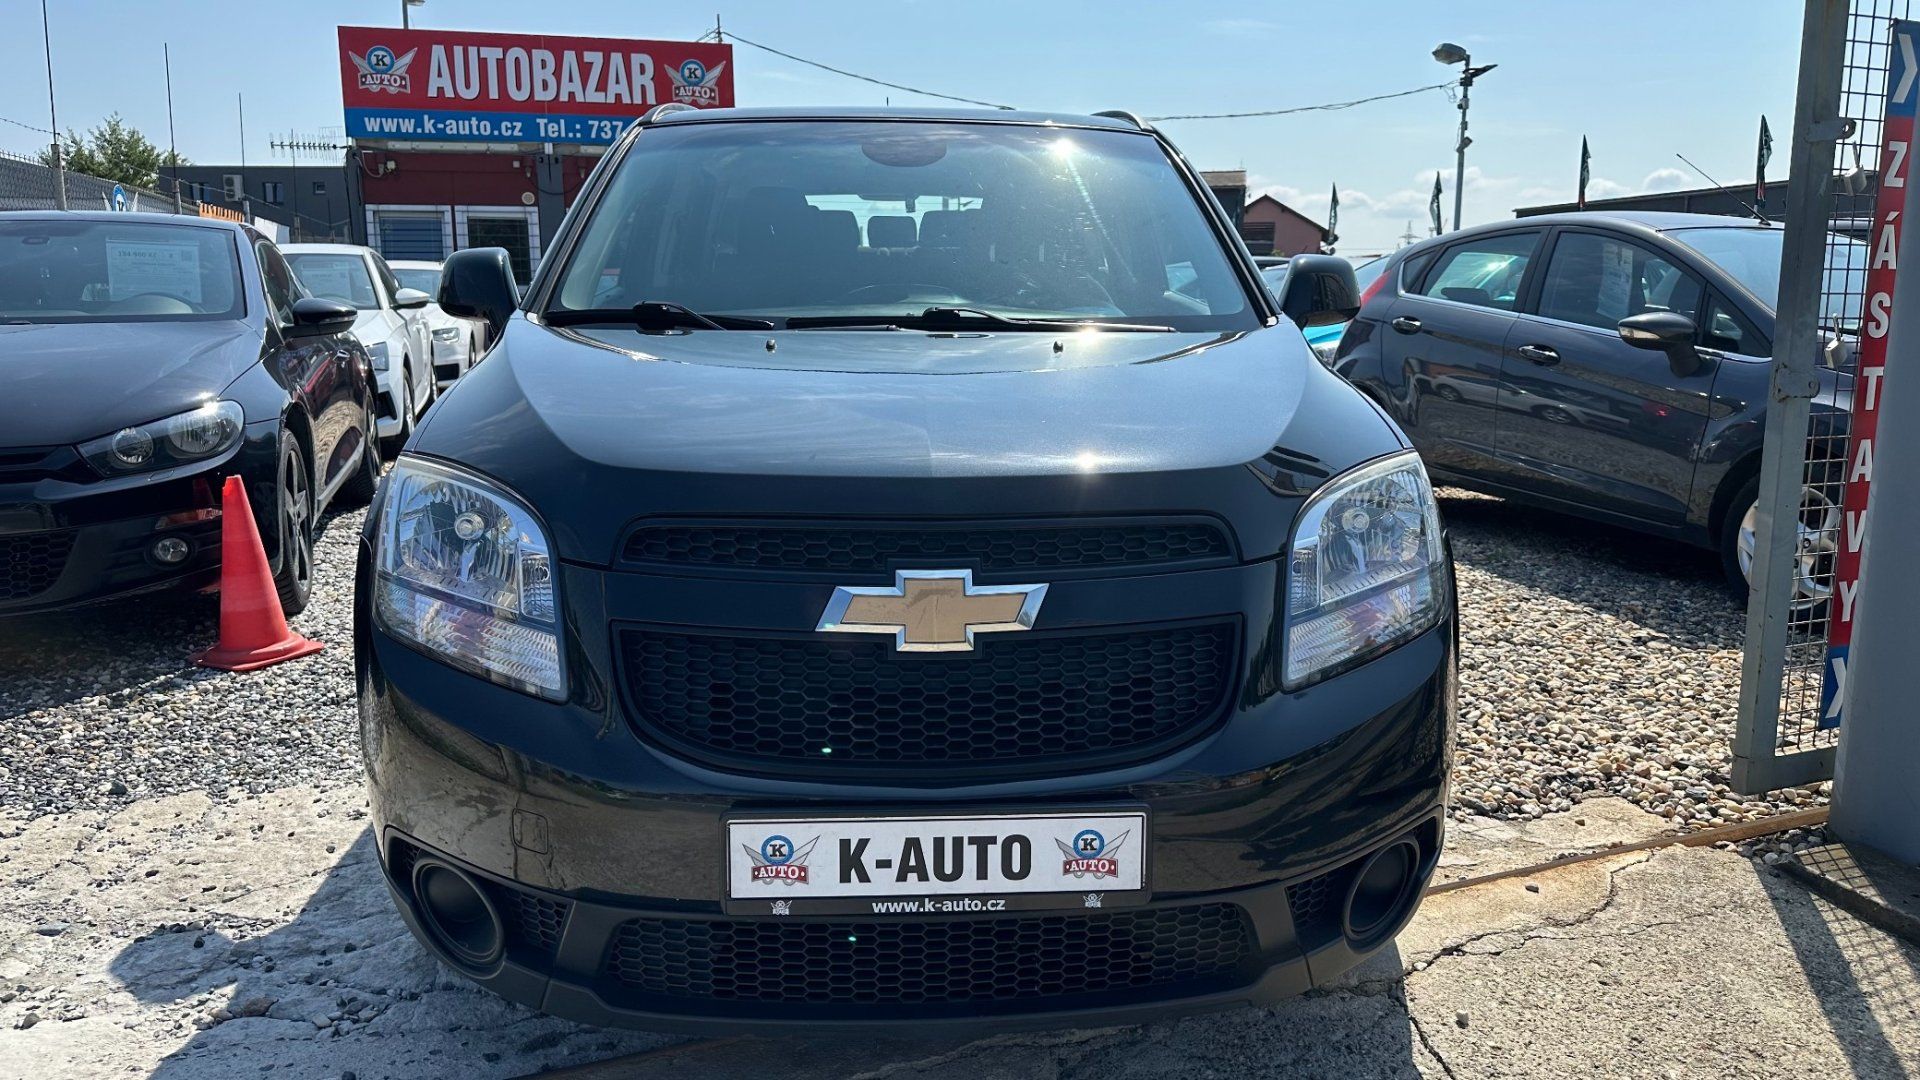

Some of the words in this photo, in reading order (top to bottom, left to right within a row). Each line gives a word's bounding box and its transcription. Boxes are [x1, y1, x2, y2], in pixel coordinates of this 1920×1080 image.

[373, 54, 388, 67] K
[427, 44, 656, 105] AUTOBAZAR
[686, 67, 700, 79] K
[365, 74, 401, 87] AUTO
[678, 86, 711, 99] AUTO
[364, 114, 524, 137] www.k-auto.cz
[536, 117, 582, 138] Tel.:
[588, 120, 624, 140] 737
[1839, 141, 1909, 622] ZÁSTAVY
[769, 843, 786, 857] K
[1080, 837, 1098, 851] K
[838, 833, 1032, 884] K-AUTO
[758, 866, 799, 879] AUTO
[1069, 859, 1110, 873] AUTO
[871, 897, 1006, 914] www.k-auto.cz
